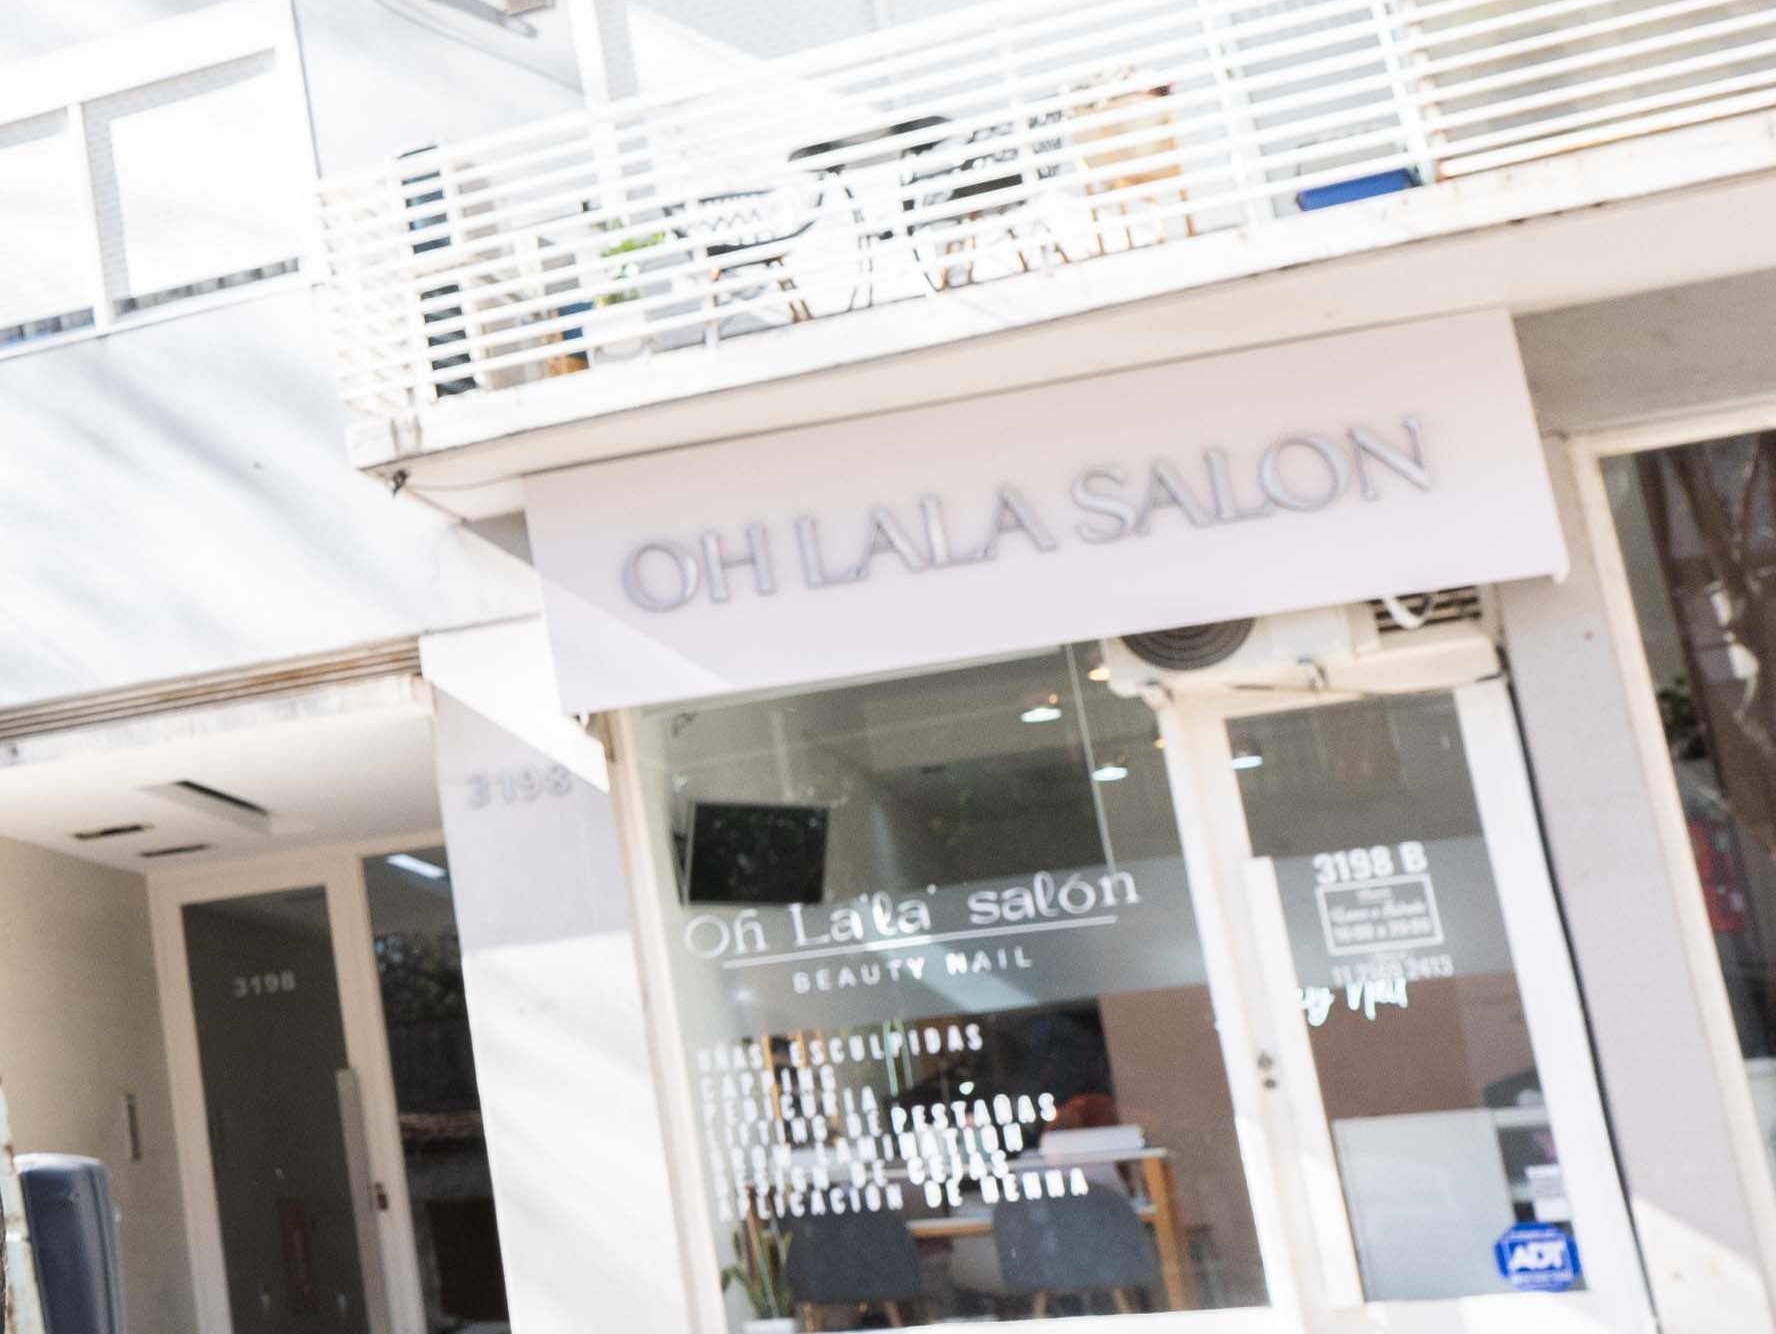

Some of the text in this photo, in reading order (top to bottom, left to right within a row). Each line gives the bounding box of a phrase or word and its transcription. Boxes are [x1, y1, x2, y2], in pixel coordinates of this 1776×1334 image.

[621, 415, 1435, 613] OH LALA SALON
[1313, 846, 1395, 886] 3198
[684, 908, 769, 959] Oh
[234, 971, 296, 997] 3198
[793, 947, 1033, 994] BEAUTY NAIL
[789, 1024, 984, 1067] ESCULPIDAS
[925, 1181, 963, 1207] DE
[1506, 1243, 1566, 1274] ADT
